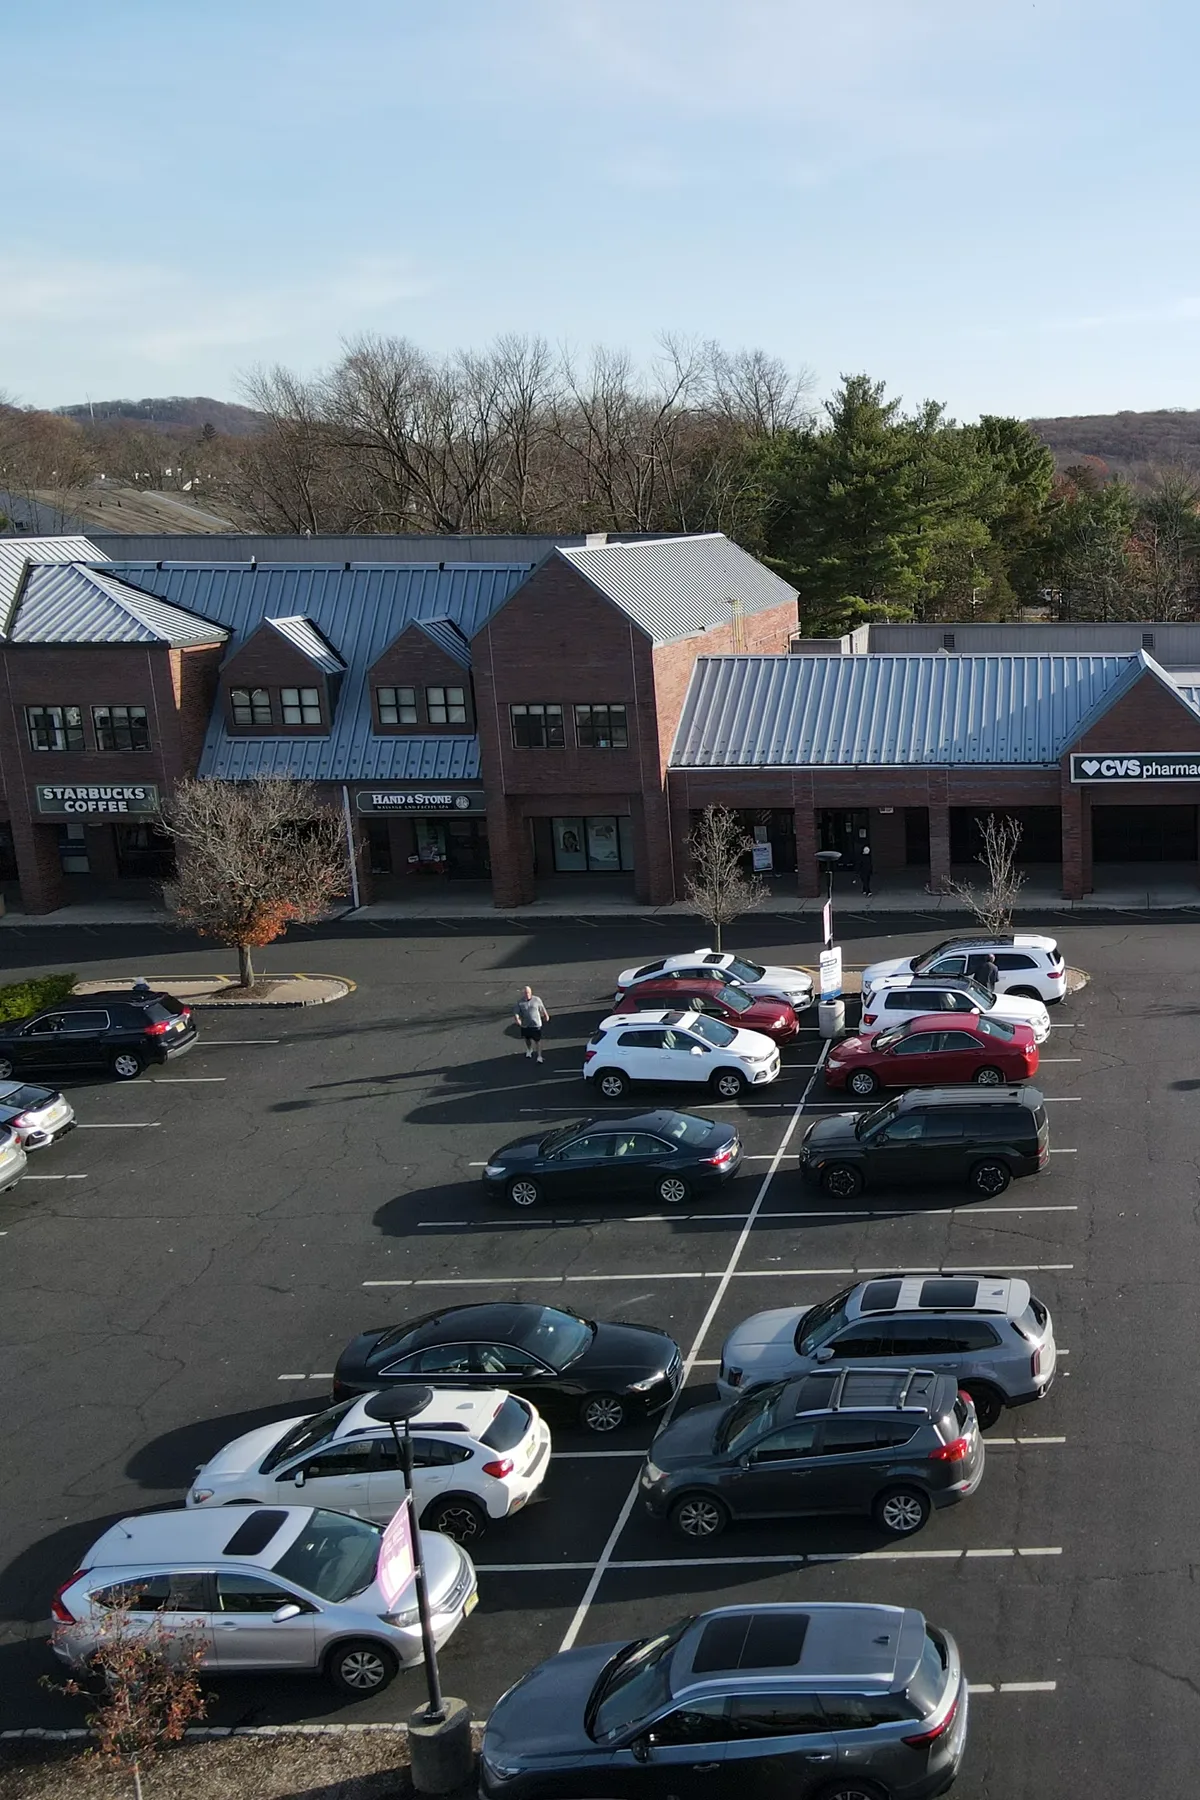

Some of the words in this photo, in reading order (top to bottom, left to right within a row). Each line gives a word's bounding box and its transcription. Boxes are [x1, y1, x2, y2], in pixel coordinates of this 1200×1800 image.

[1100, 759, 1141, 776] CVS
[43, 788, 145, 800] STARBUCKS
[372, 794, 405, 805] HAND
[406, 795, 414, 804] &
[414, 794, 452, 805] STONE
[64, 801, 129, 813] COFFEE
